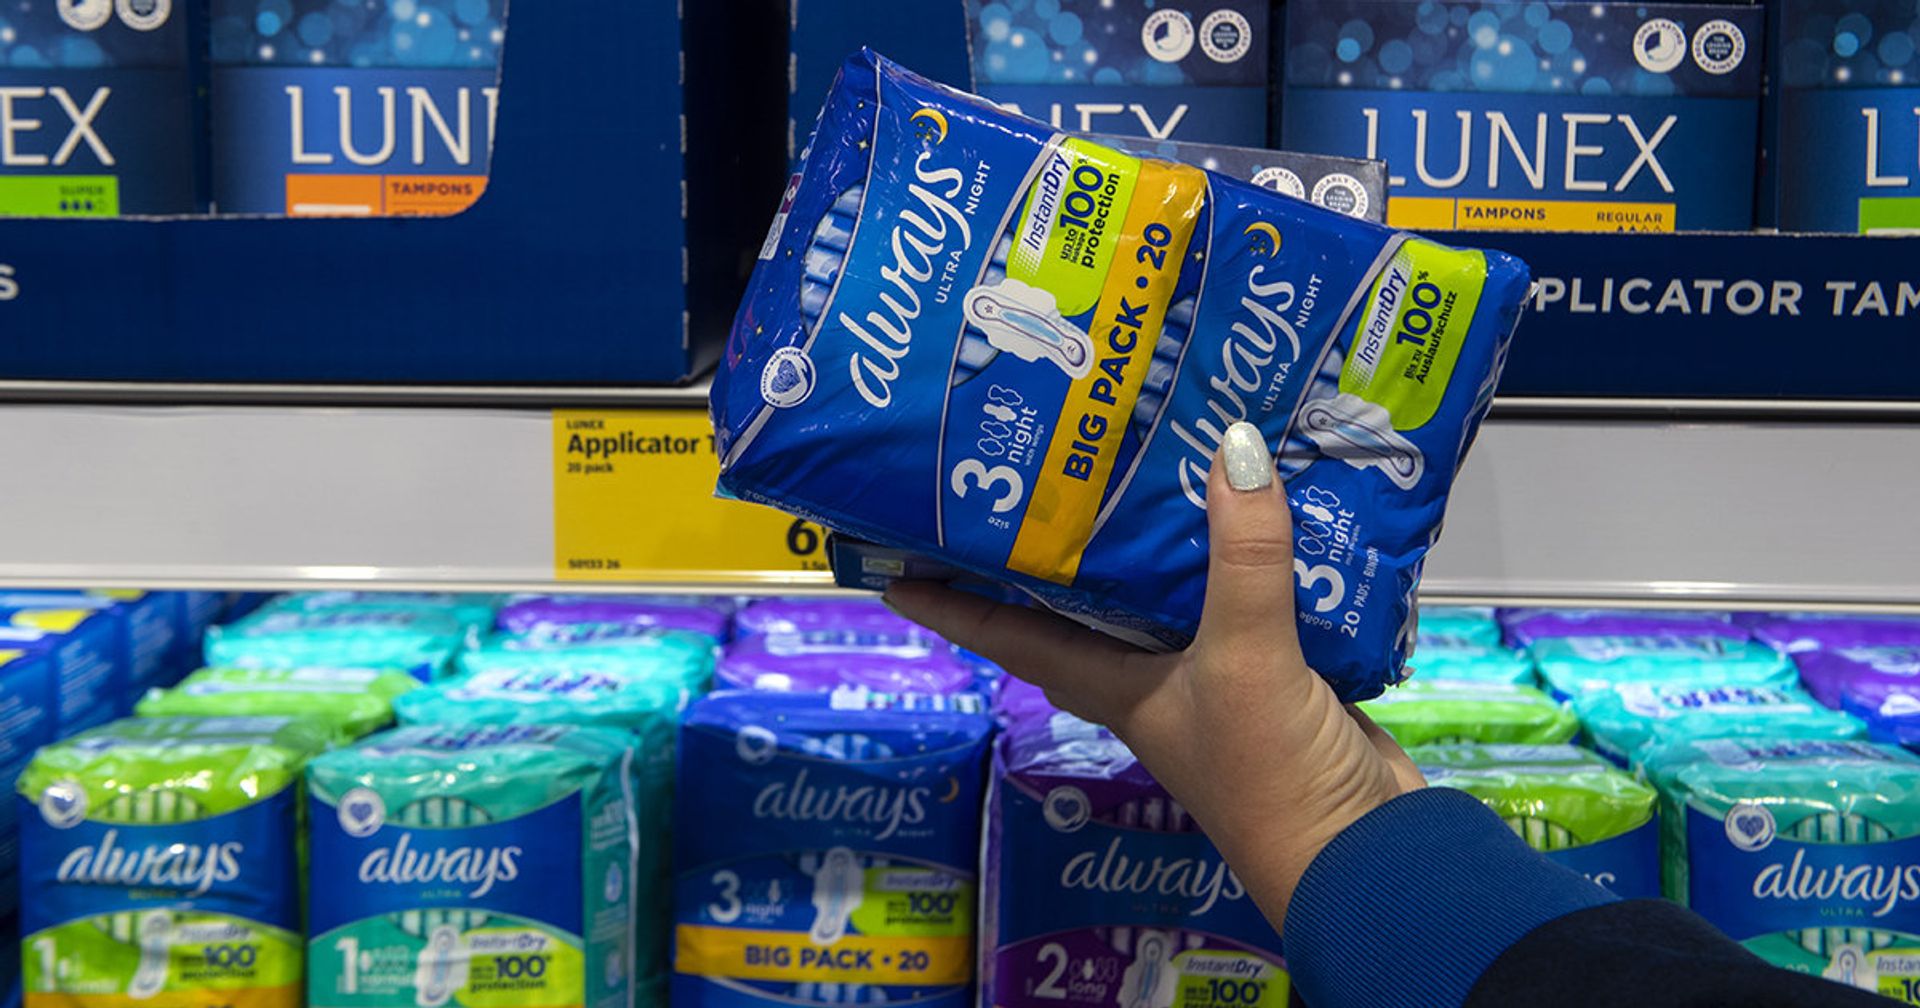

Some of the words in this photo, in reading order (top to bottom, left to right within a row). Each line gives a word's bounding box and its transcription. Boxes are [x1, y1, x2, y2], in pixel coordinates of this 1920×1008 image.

[1362, 108, 1678, 193] LUNEX
[391, 182, 474, 196] TAMPONS
[1023, 152, 1071, 251] InstantDry
[1463, 206, 1547, 221] TAMPONS
[1596, 211, 1663, 224] REGULAR
[935, 250, 963, 304] ULTRA
[964, 160, 991, 215] NIGHT
[1080, 172, 1121, 269] protection
[839, 150, 972, 409] always
[1261, 361, 1292, 412] ULTRA
[1295, 273, 1323, 328] NIGHT
[1357, 268, 1408, 365] InstantDry
[1415, 291, 1458, 385] Auslaufschutz
[1062, 413, 1108, 482] BIG
[1089, 295, 1150, 407] PACK
[1136, 222, 1173, 271] 20
[566, 420, 605, 430] LUNEX
[567, 431, 700, 459] Applicator
[1007, 406, 1039, 464] night
[584, 462, 613, 475] pack
[951, 458, 1024, 513] 3
[1328, 508, 1355, 563] night
[1340, 610, 1361, 639] 20
[1354, 582, 1371, 609] PADS
[754, 767, 931, 841] always
[57, 828, 244, 898] always
[359, 832, 522, 899] always
[1061, 836, 1246, 917] always
[1753, 848, 1920, 918] always
[708, 869, 743, 924] 3
[1820, 907, 1865, 917] ULTRA
[33, 937, 57, 992] 1
[335, 937, 358, 995] 1
[745, 945, 791, 967] BIG
[799, 948, 873, 971] PACK
[898, 951, 930, 972] 20
[1034, 942, 1069, 999] 2
[1068, 981, 1107, 1000] long
[1185, 956, 1265, 979] InstantDry
